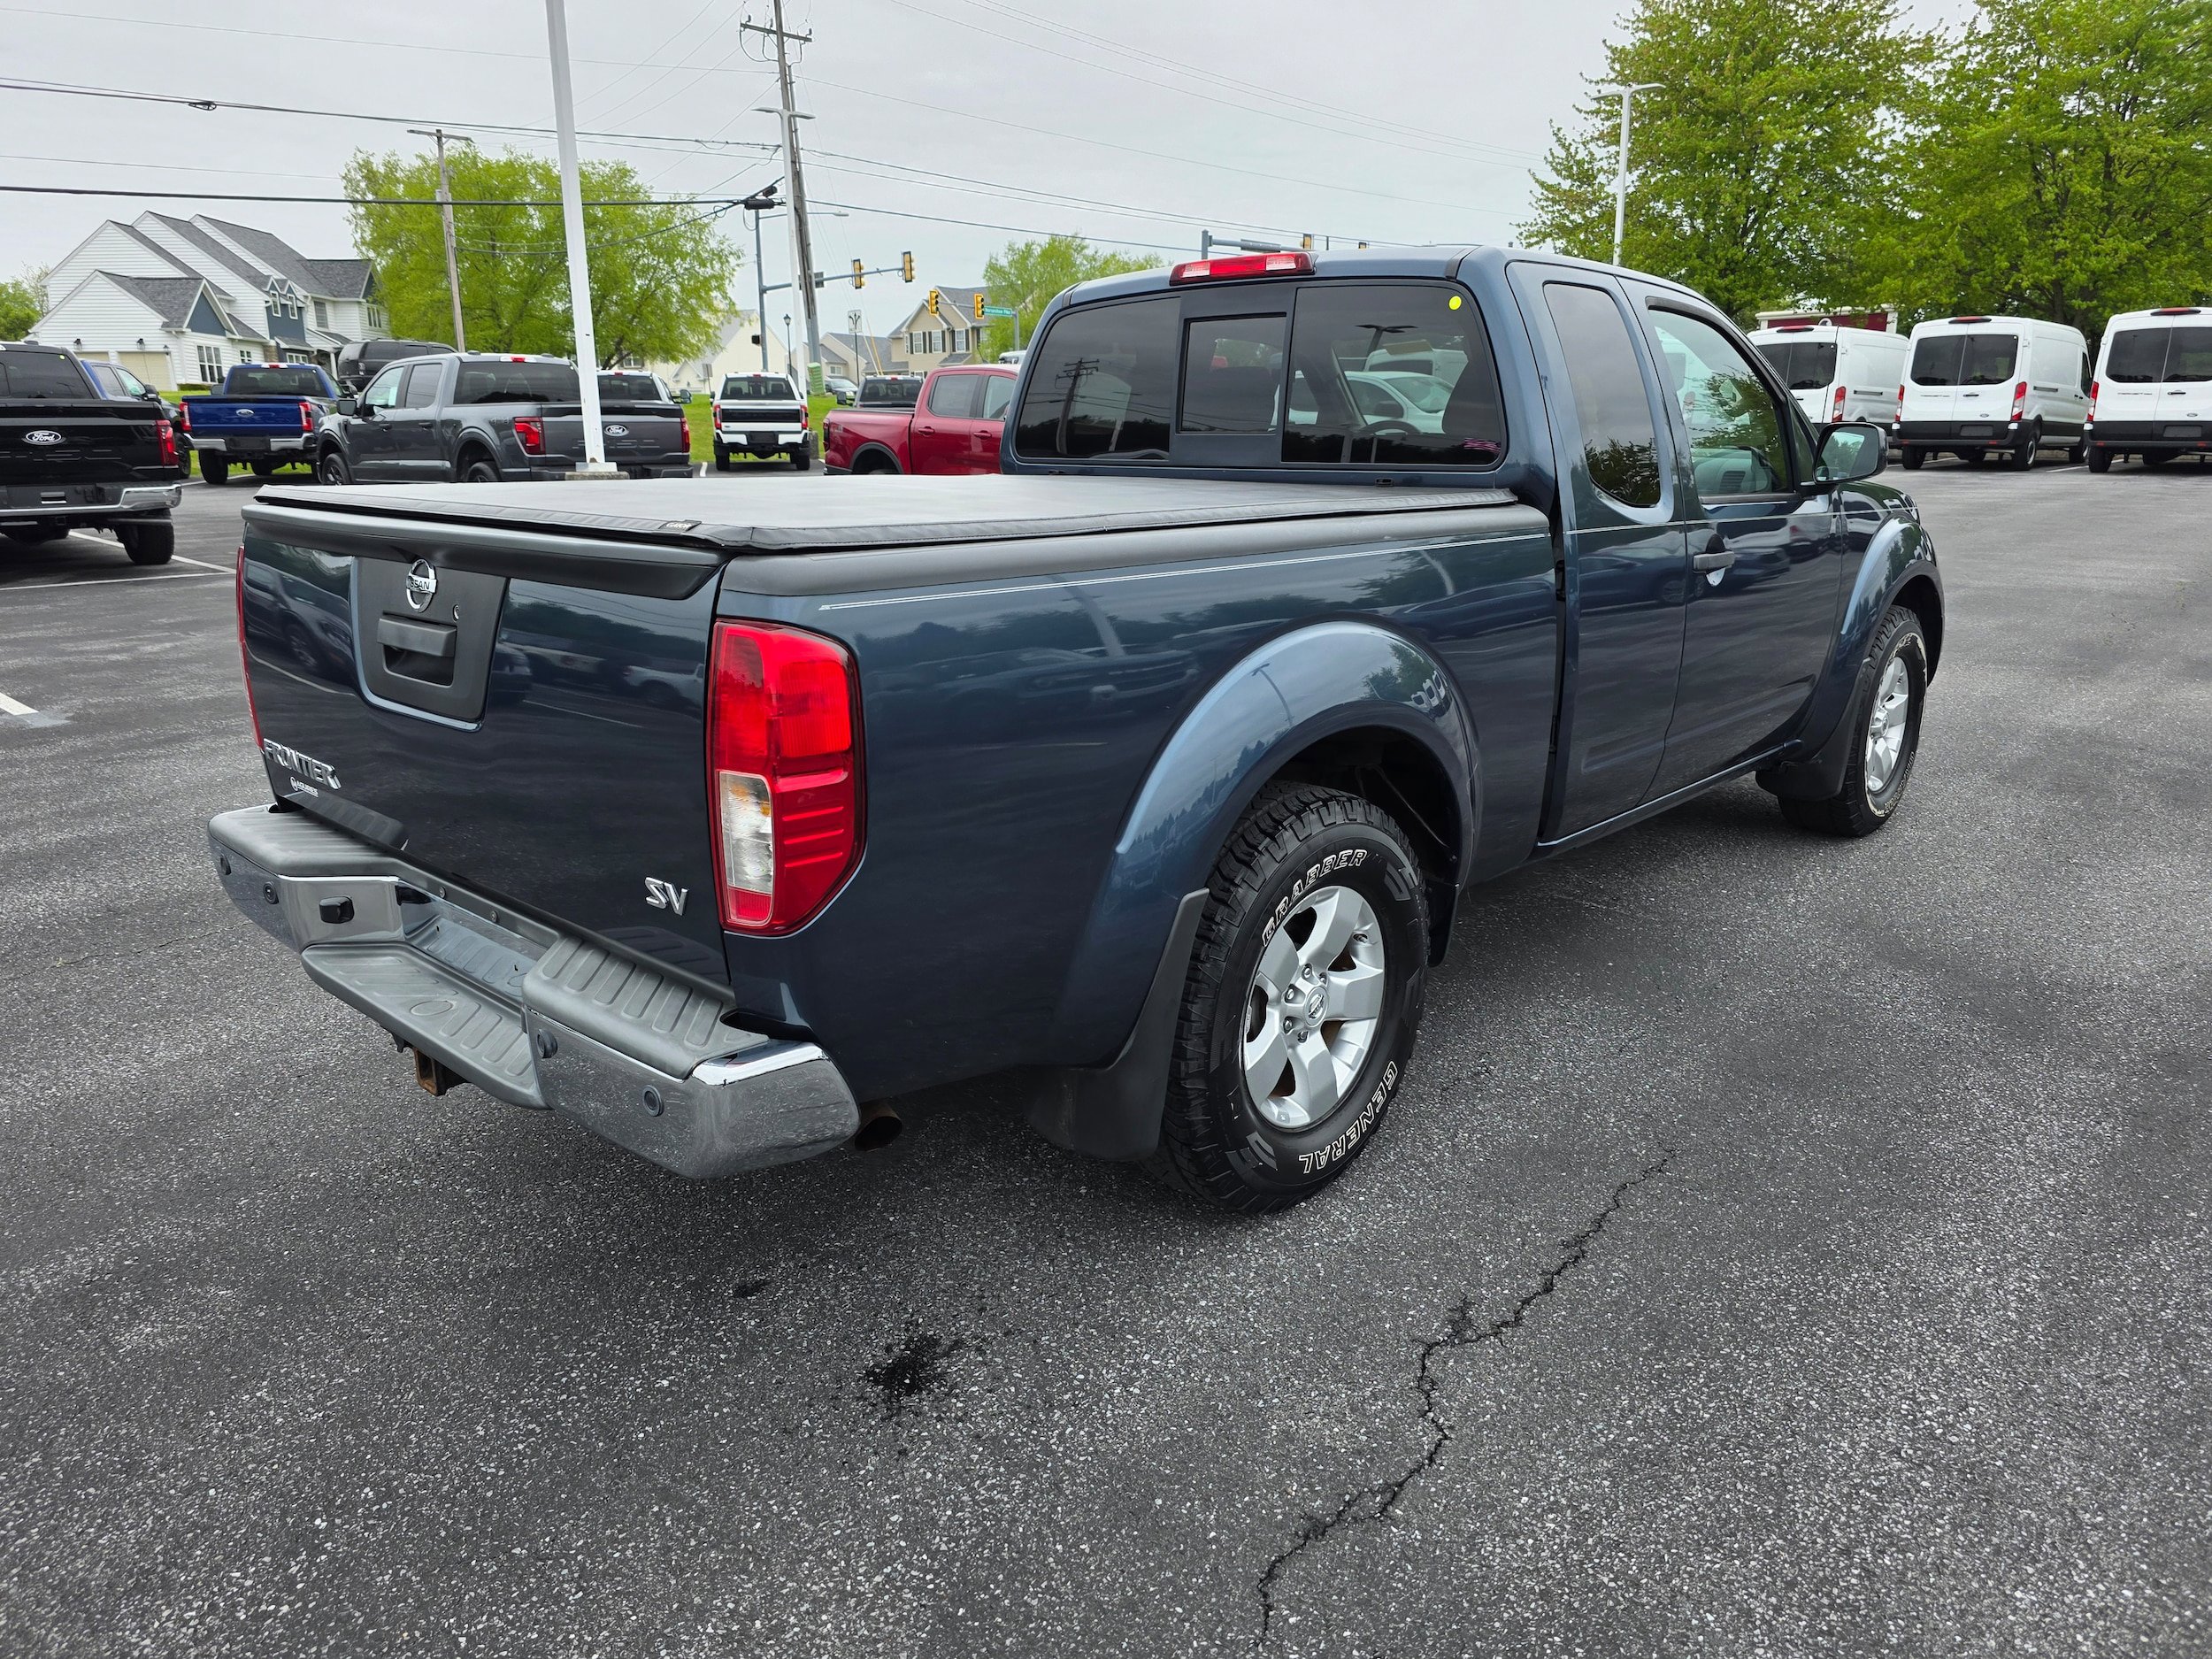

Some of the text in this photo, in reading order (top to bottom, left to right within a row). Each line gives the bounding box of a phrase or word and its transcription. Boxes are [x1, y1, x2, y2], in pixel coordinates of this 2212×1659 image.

[32, 432, 56, 442] Ford
[263, 737, 342, 790] FRONTIER
[644, 876, 688, 917] SV
[1262, 849, 1368, 948] GRABBER
[1298, 1060, 1399, 1175] GENERAL
